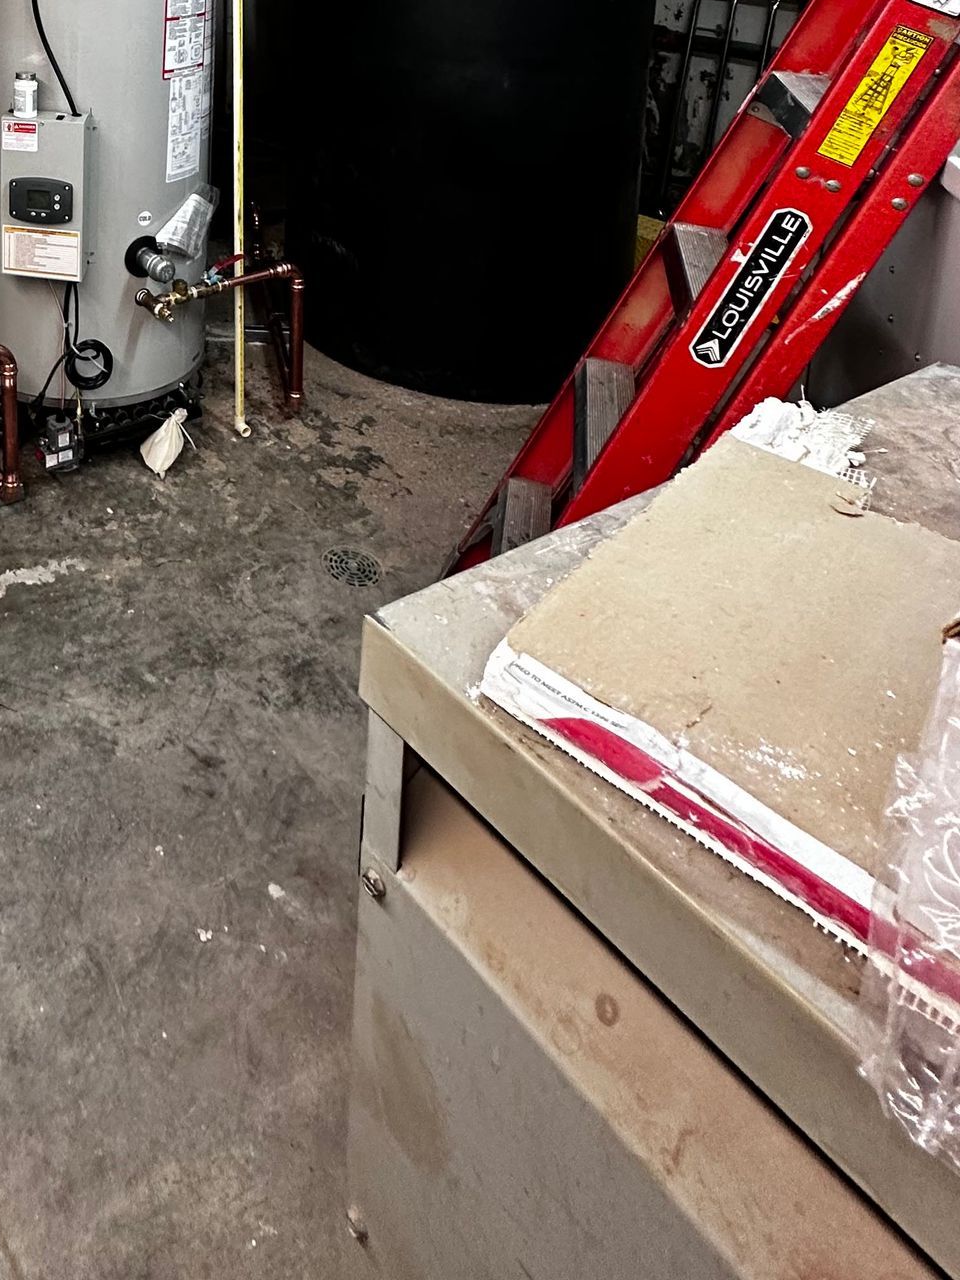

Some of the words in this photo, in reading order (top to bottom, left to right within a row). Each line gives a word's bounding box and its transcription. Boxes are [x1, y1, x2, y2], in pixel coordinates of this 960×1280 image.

[898, 27, 930, 42] CAUTION
[712, 214, 802, 339] LOUISVILLE
[541, 681, 561, 695] MEET
